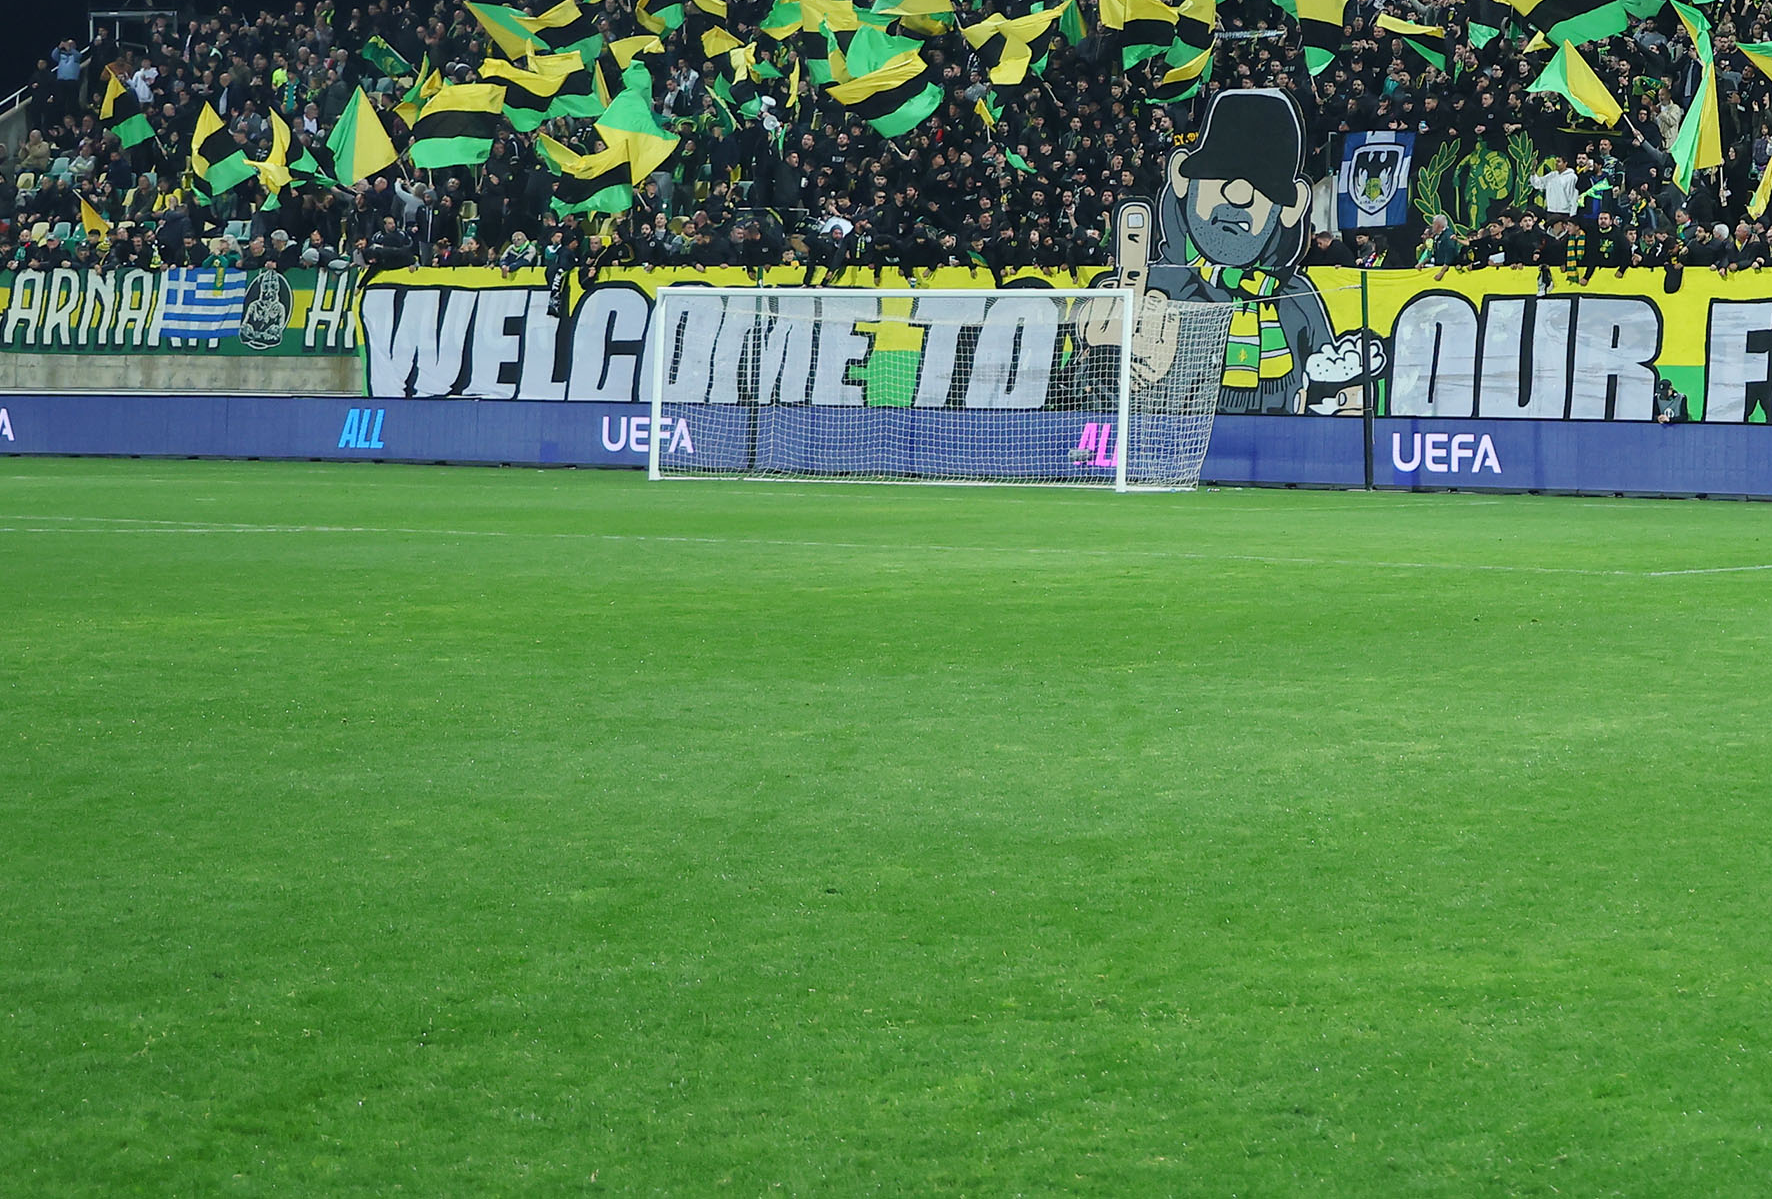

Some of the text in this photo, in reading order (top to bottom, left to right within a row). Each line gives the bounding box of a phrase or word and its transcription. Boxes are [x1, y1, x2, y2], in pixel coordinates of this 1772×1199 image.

[0, 268, 219, 348] ARNA
[362, 287, 881, 406] WELCOME
[910, 290, 1060, 409] TO
[1390, 294, 1660, 421] OUR
[338, 408, 385, 449] ALL
[1392, 432, 1502, 474] UEFA
